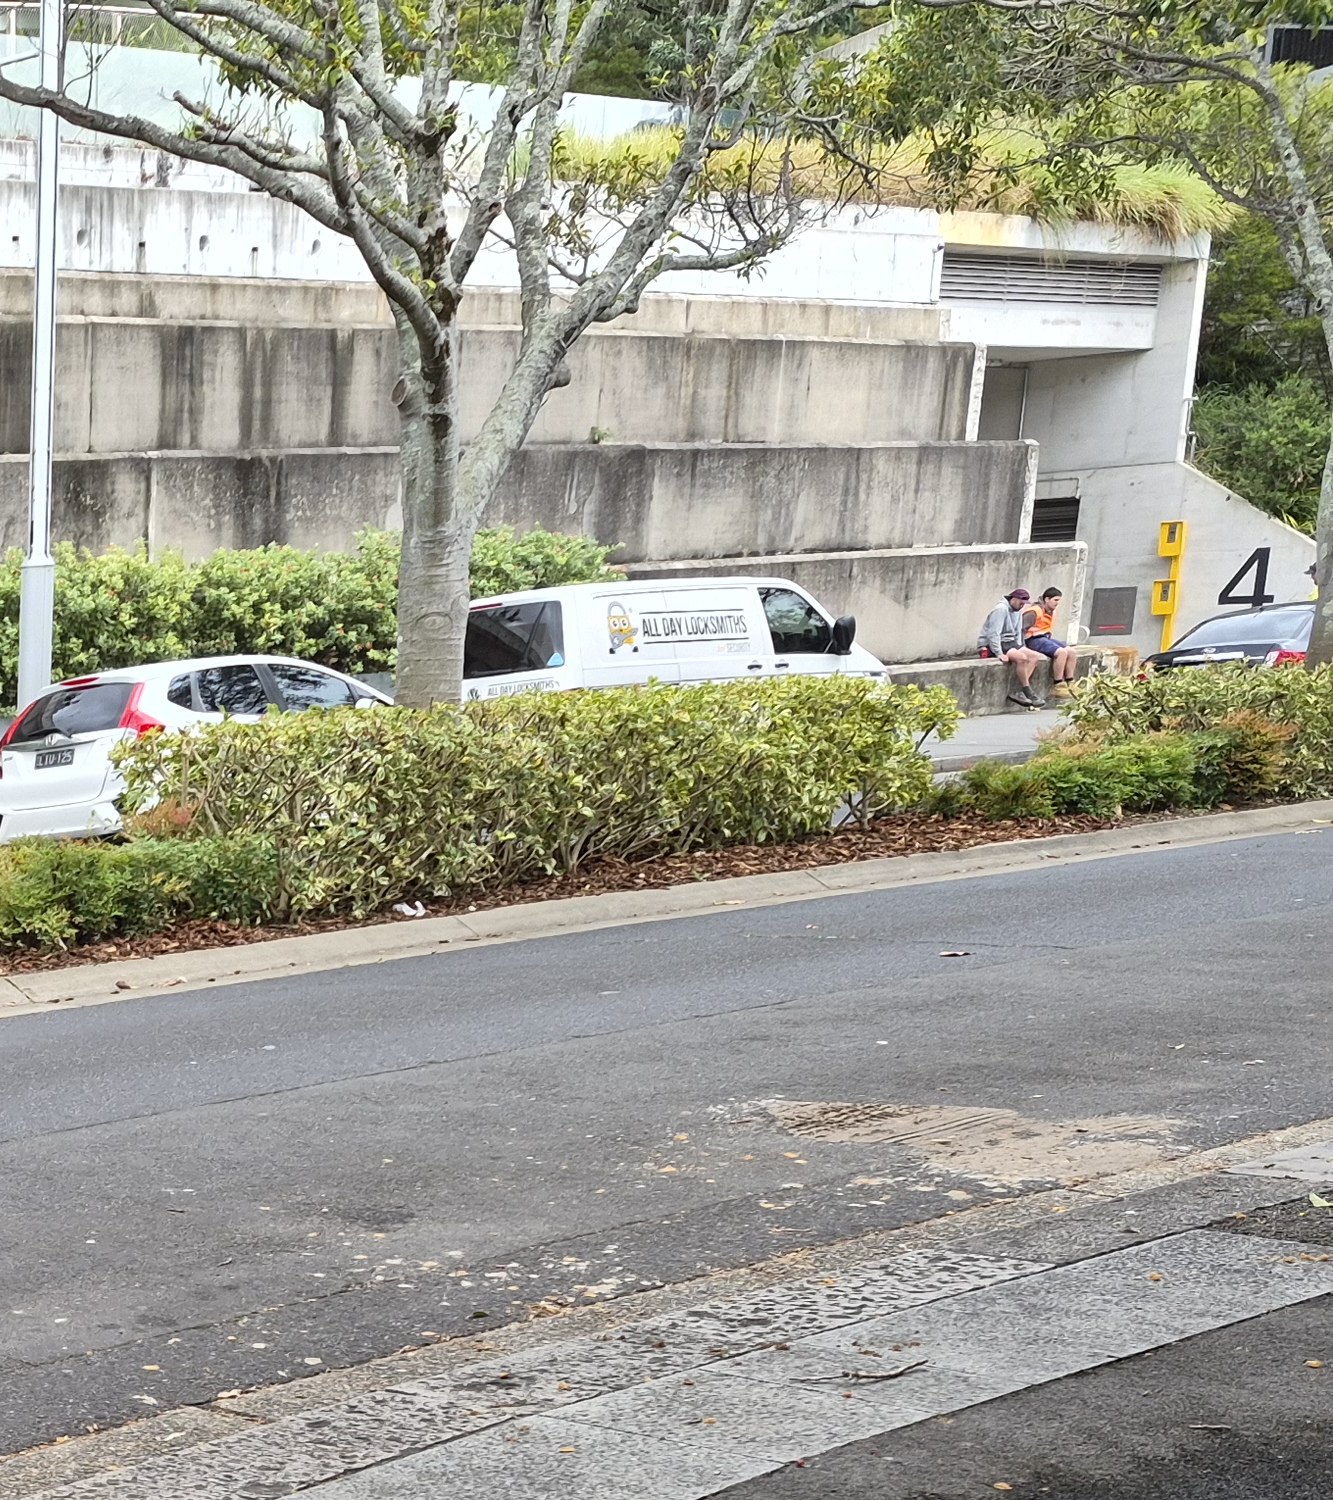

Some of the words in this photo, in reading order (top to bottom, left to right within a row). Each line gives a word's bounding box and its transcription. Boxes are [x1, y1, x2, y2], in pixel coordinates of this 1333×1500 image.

[1218, 547, 1275, 607] 4
[642, 618, 662, 637] ALL
[662, 616, 683, 636] DAY
[684, 615, 748, 635] LOCKSMITHS
